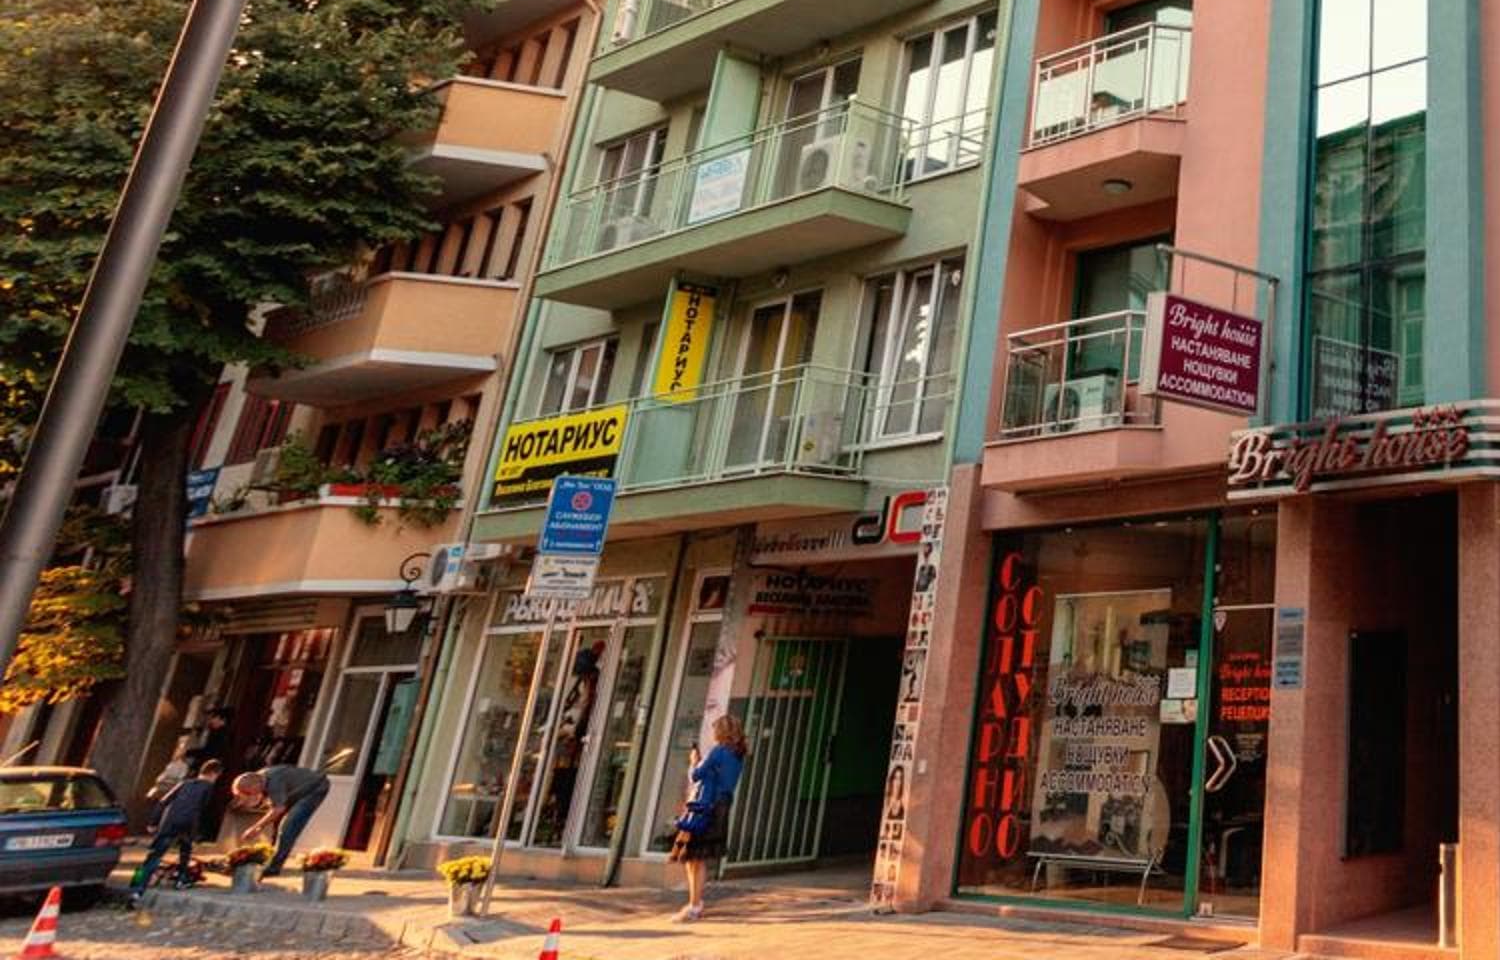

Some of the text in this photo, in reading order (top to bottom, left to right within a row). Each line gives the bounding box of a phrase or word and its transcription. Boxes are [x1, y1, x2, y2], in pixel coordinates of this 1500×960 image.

[670, 292, 700, 392] НОТАРИУС
[1169, 304, 1256, 347] Bright house
[1172, 336, 1251, 369] НАСТАНЯВАНЕ
[1183, 359, 1238, 384] НОЩУВКИ
[1160, 372, 1255, 407] ACCOMMODATION
[504, 418, 618, 462] НОТАРИУС
[1228, 421, 1469, 492] Bright house
[1221, 687, 1272, 701] RECEPTIO
[1053, 717, 1147, 737] НАСТАНЯВАНЕ
[1067, 744, 1129, 766] НОЩУВКИ
[1040, 769, 1152, 795] ACCOMMODATION
